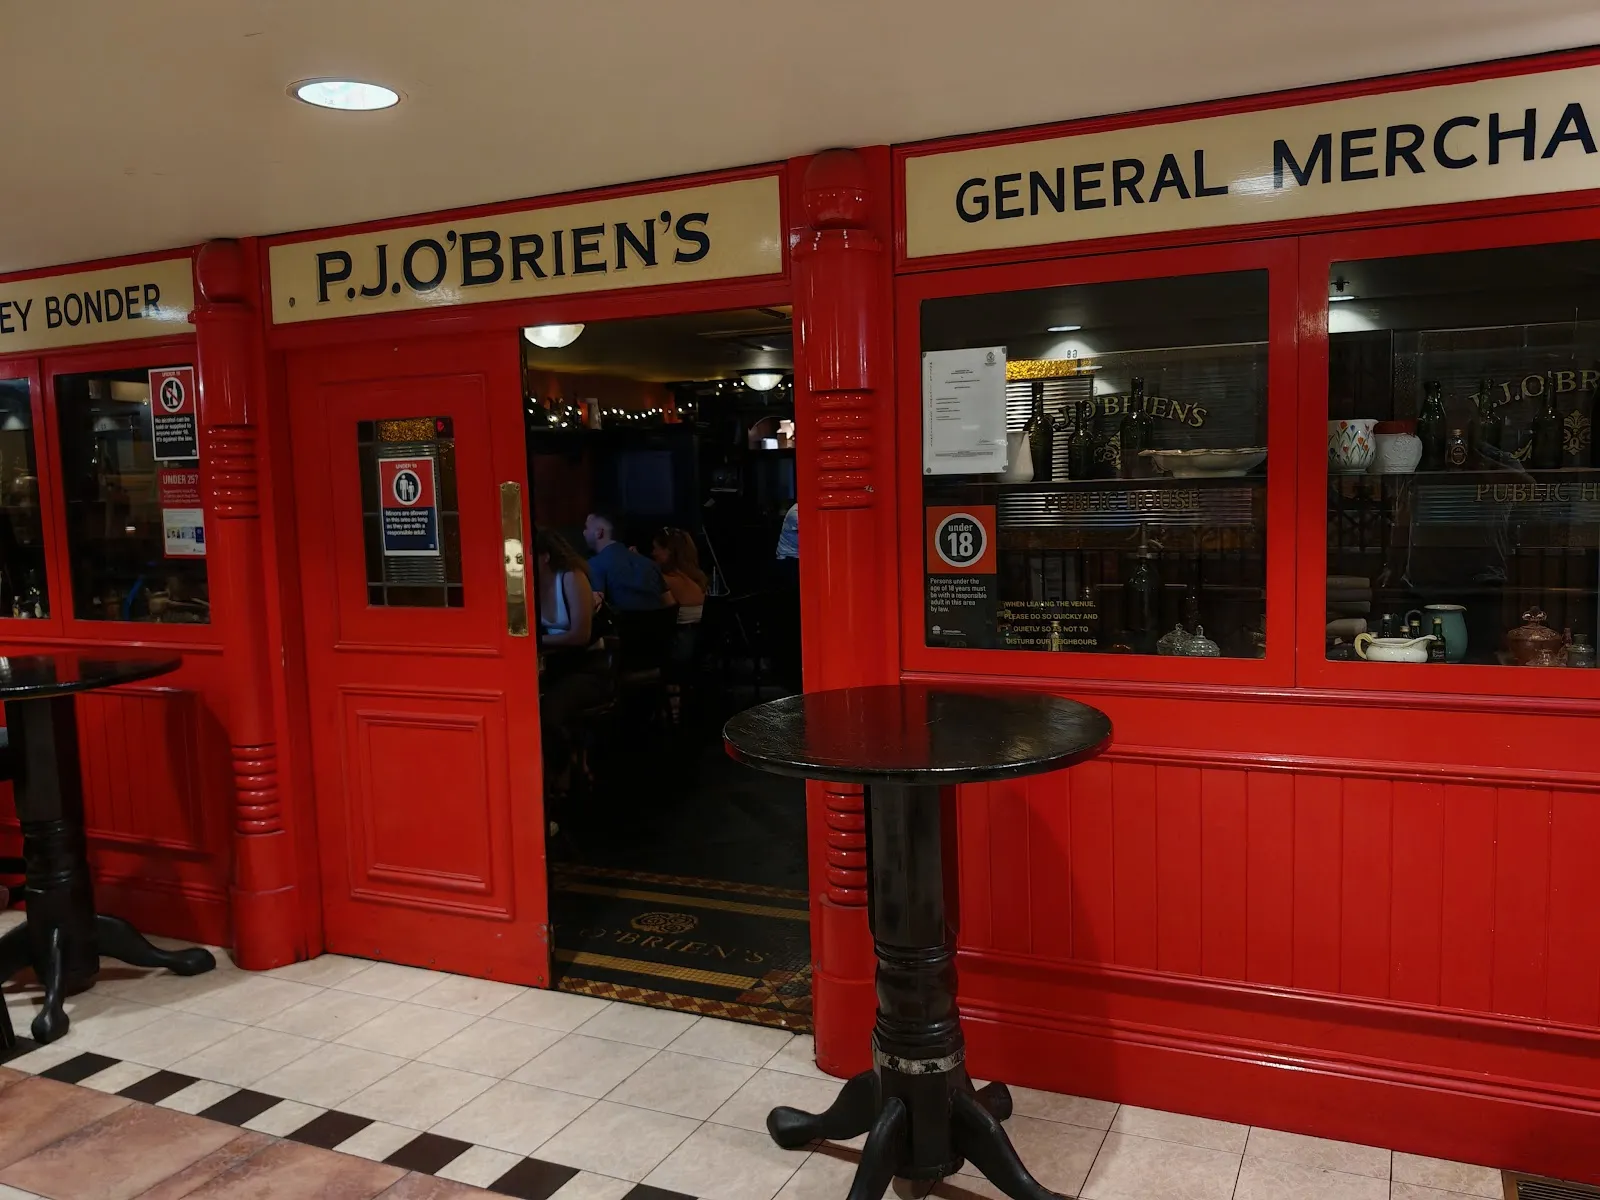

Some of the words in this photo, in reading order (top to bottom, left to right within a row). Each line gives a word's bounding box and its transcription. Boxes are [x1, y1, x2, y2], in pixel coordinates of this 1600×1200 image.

[954, 148, 1229, 224] GENERAL
[1272, 102, 1599, 190] MERCHA
[315, 209, 711, 304] P.J.O'BRIEN'S
[0, 298, 33, 334] EY
[45, 283, 161, 329] BONDER
[163, 474, 186, 484] UNDER
[187, 474, 198, 484] 25?
[1044, 492, 1119, 513] PUBLIC
[1125, 489, 1200, 511] HOUSE
[1474, 482, 1570, 502] PUBLIC
[948, 523, 973, 532] under
[948, 532, 973, 557] 18
